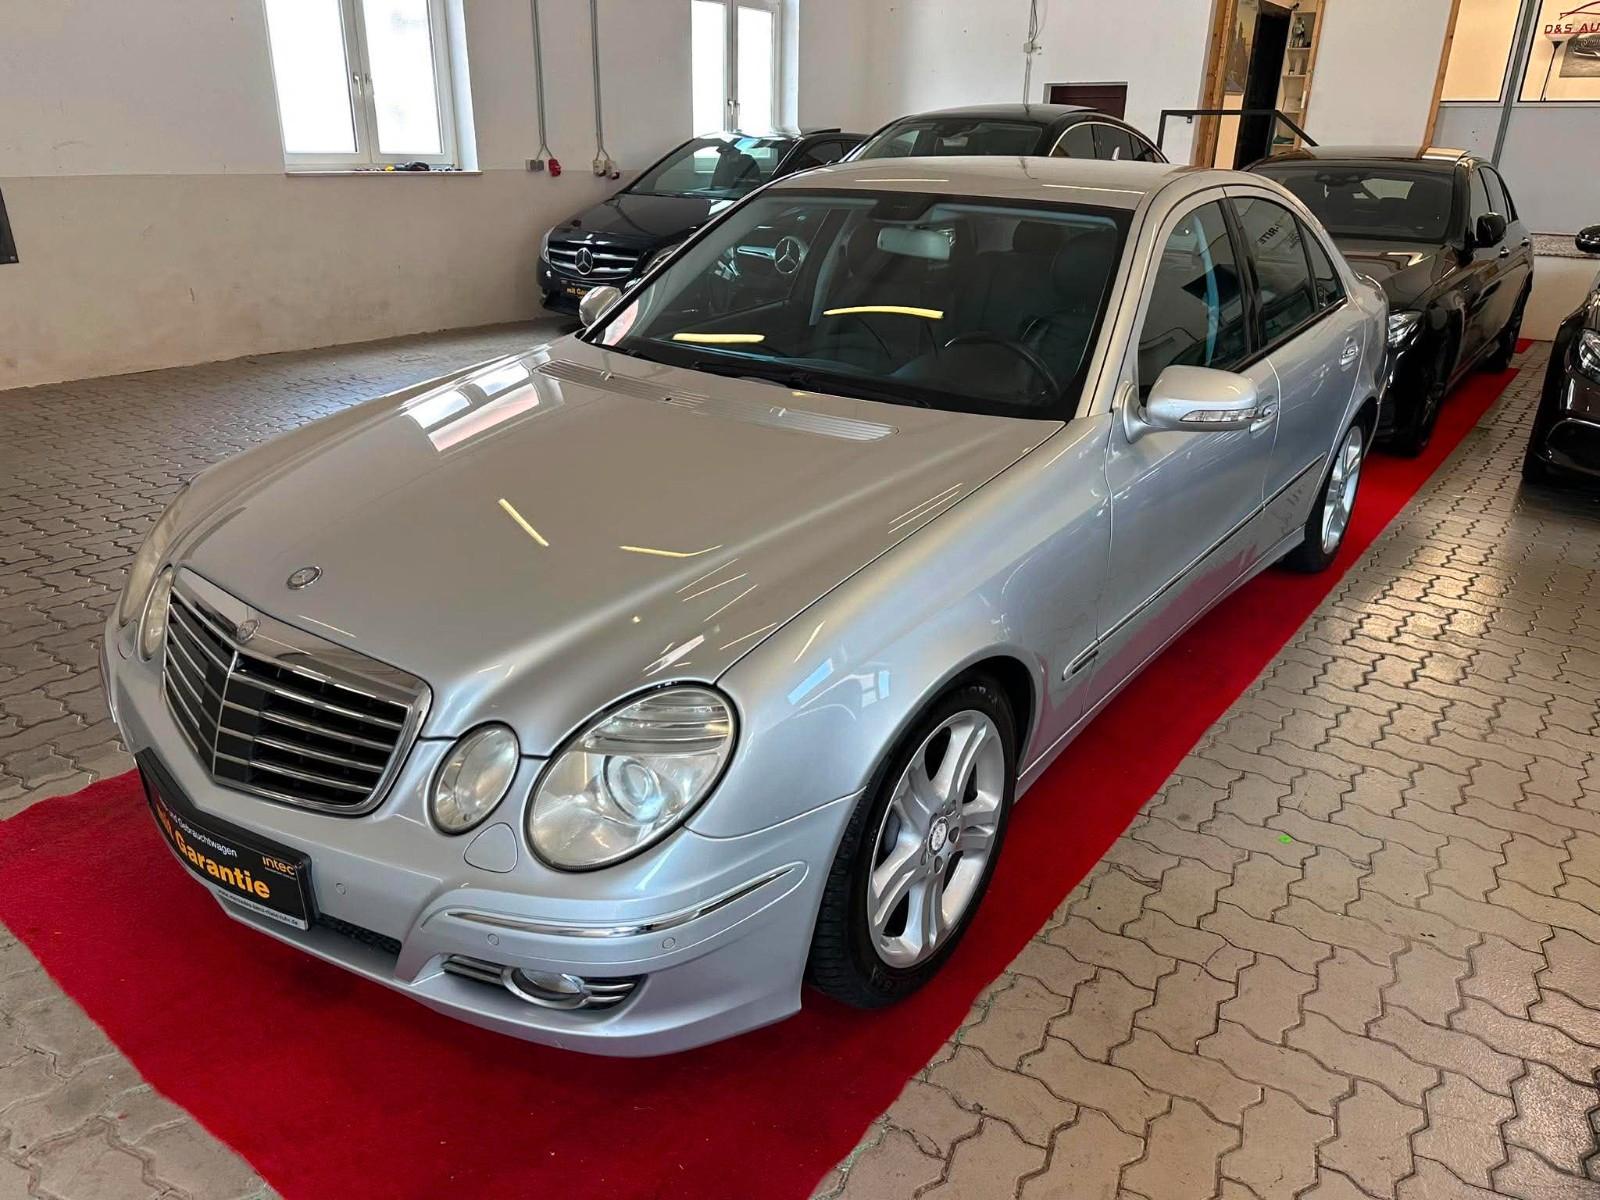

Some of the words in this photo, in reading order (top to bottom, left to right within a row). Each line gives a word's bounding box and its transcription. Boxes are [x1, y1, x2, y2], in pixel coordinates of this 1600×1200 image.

[1544, 23, 1573, 34] D&S
[1579, 22, 1600, 33] AU
[178, 818, 238, 858] Gebrauchtwagen
[174, 830, 271, 899] Garantie
